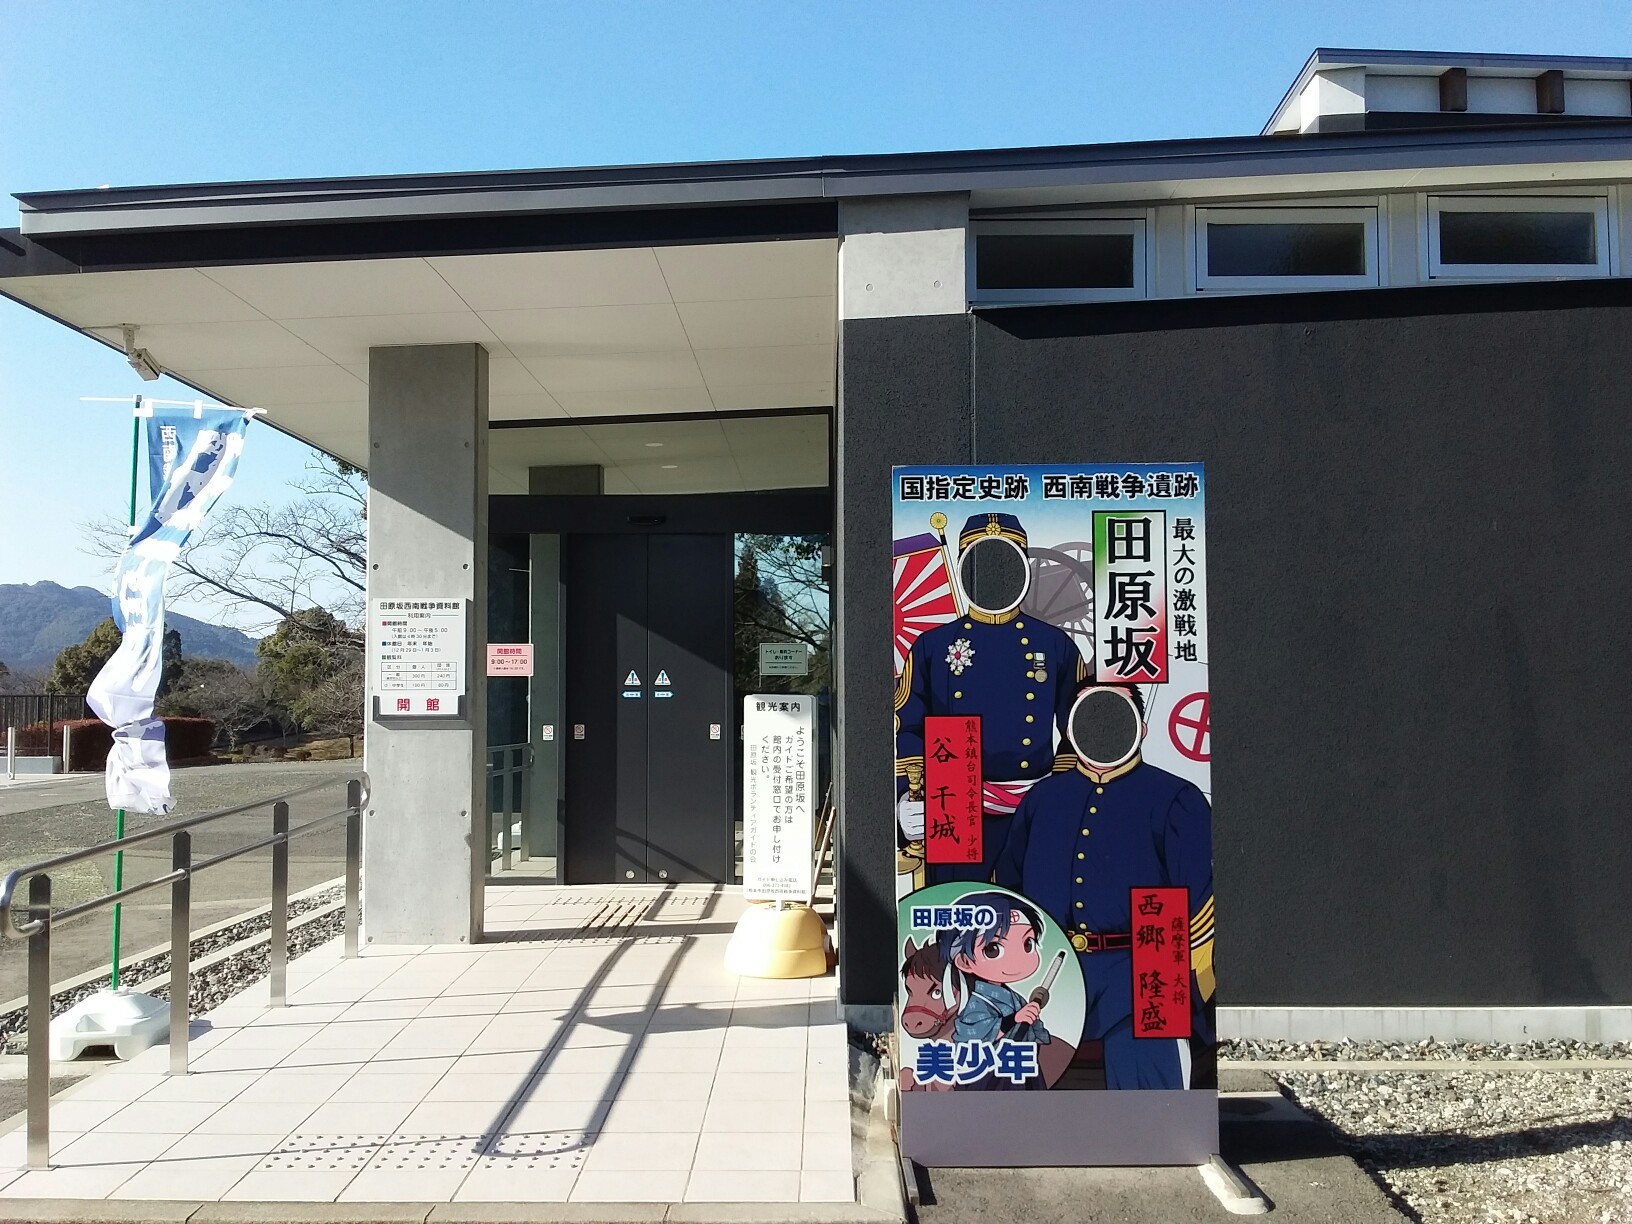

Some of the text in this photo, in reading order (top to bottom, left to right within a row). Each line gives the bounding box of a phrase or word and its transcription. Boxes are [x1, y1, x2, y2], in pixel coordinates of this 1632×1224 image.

[900, 472, 1199, 501] 国指定史跡 西南戦争遺跡
[379, 602, 460, 610] 田原坂西南戦争資料館
[1103, 516, 1161, 679] 田原坂
[1171, 518, 1198, 662] 最大の激戦地
[397, 698, 440, 712] 開館
[756, 701, 801, 712] 観光案内
[761, 735, 770, 779] ください。
[772, 735, 782, 864] 館内の受付窓口でお申し付け
[784, 735, 794, 824] ガイドご希望の方は
[795, 725, 806, 813] ようこそ田原坂へ
[964, 719, 979, 861] 熊本鎮台司令長官 少将
[912, 905, 996, 929] 田原坂の
[1170, 916, 1188, 1006] 薩摩軍 大将
[1136, 893, 1167, 1033] 西郷 隆盛
[915, 1041, 1039, 1084] 美少年
